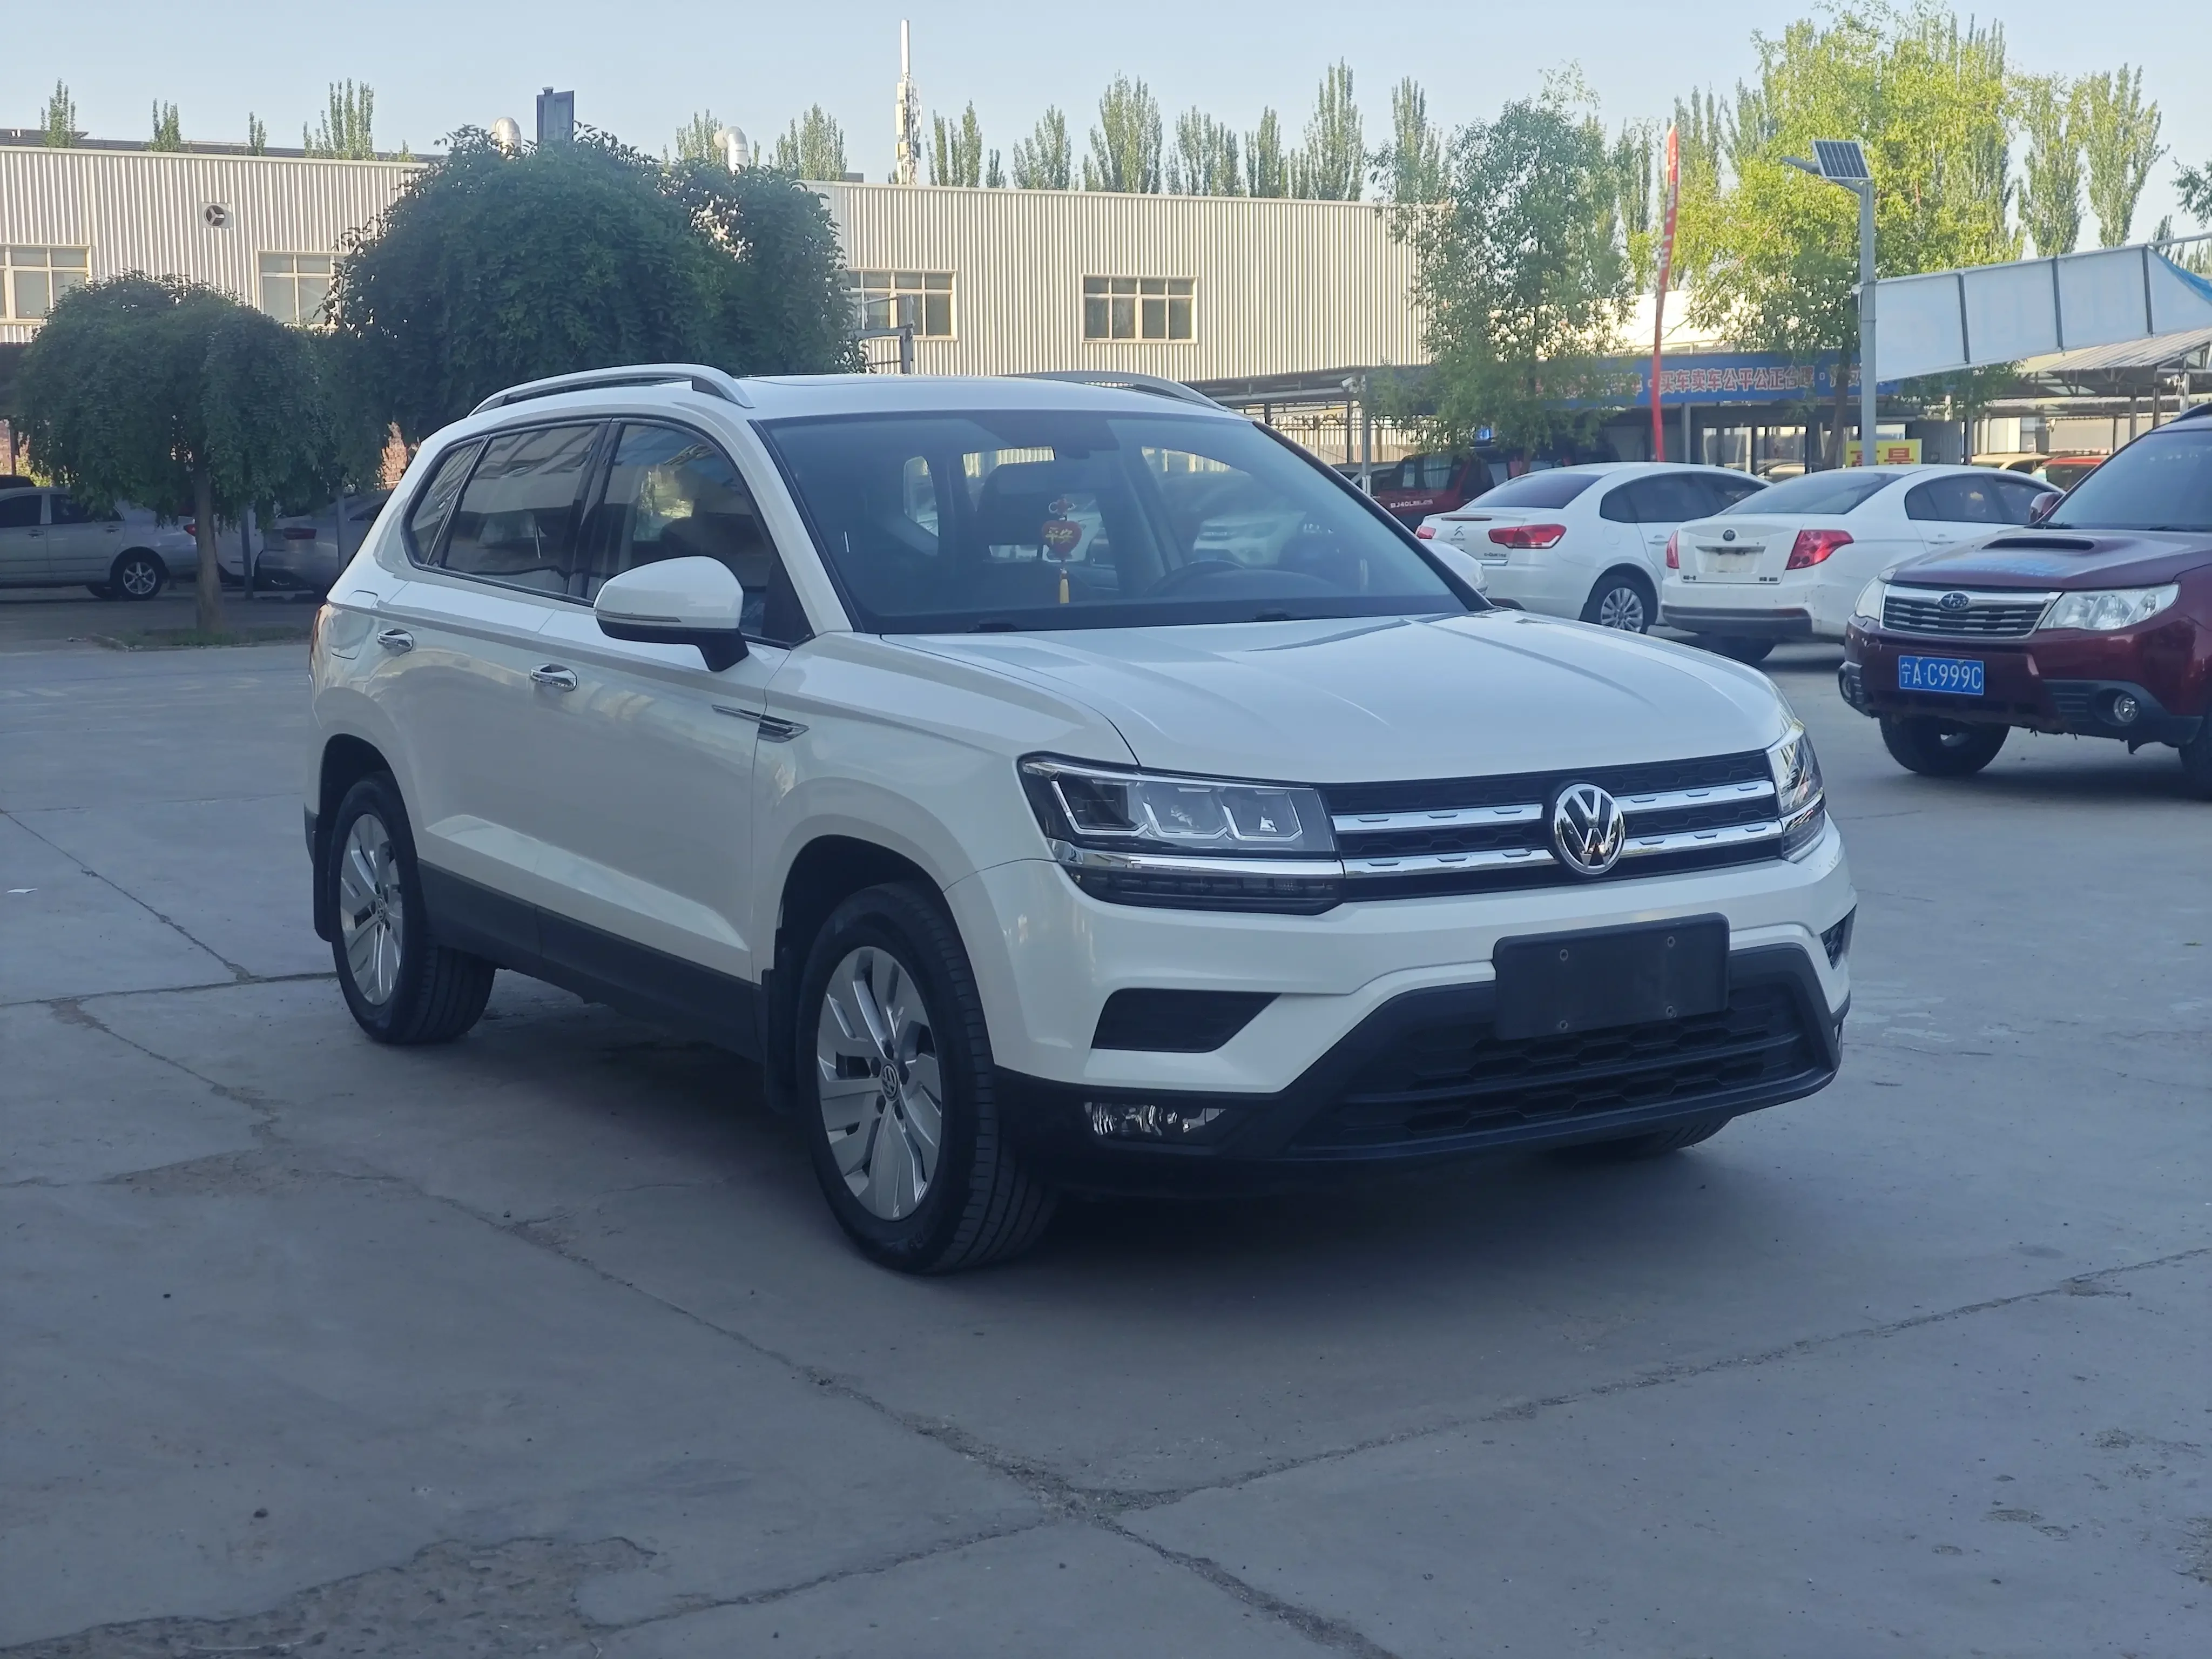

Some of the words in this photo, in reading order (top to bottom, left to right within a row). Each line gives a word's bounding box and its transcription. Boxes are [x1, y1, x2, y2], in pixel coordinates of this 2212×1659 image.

[1045, 527, 1074, 545] 平安
[1901, 662, 1981, 690] 宁A·C999C
[1555, 784, 1624, 873] VW
